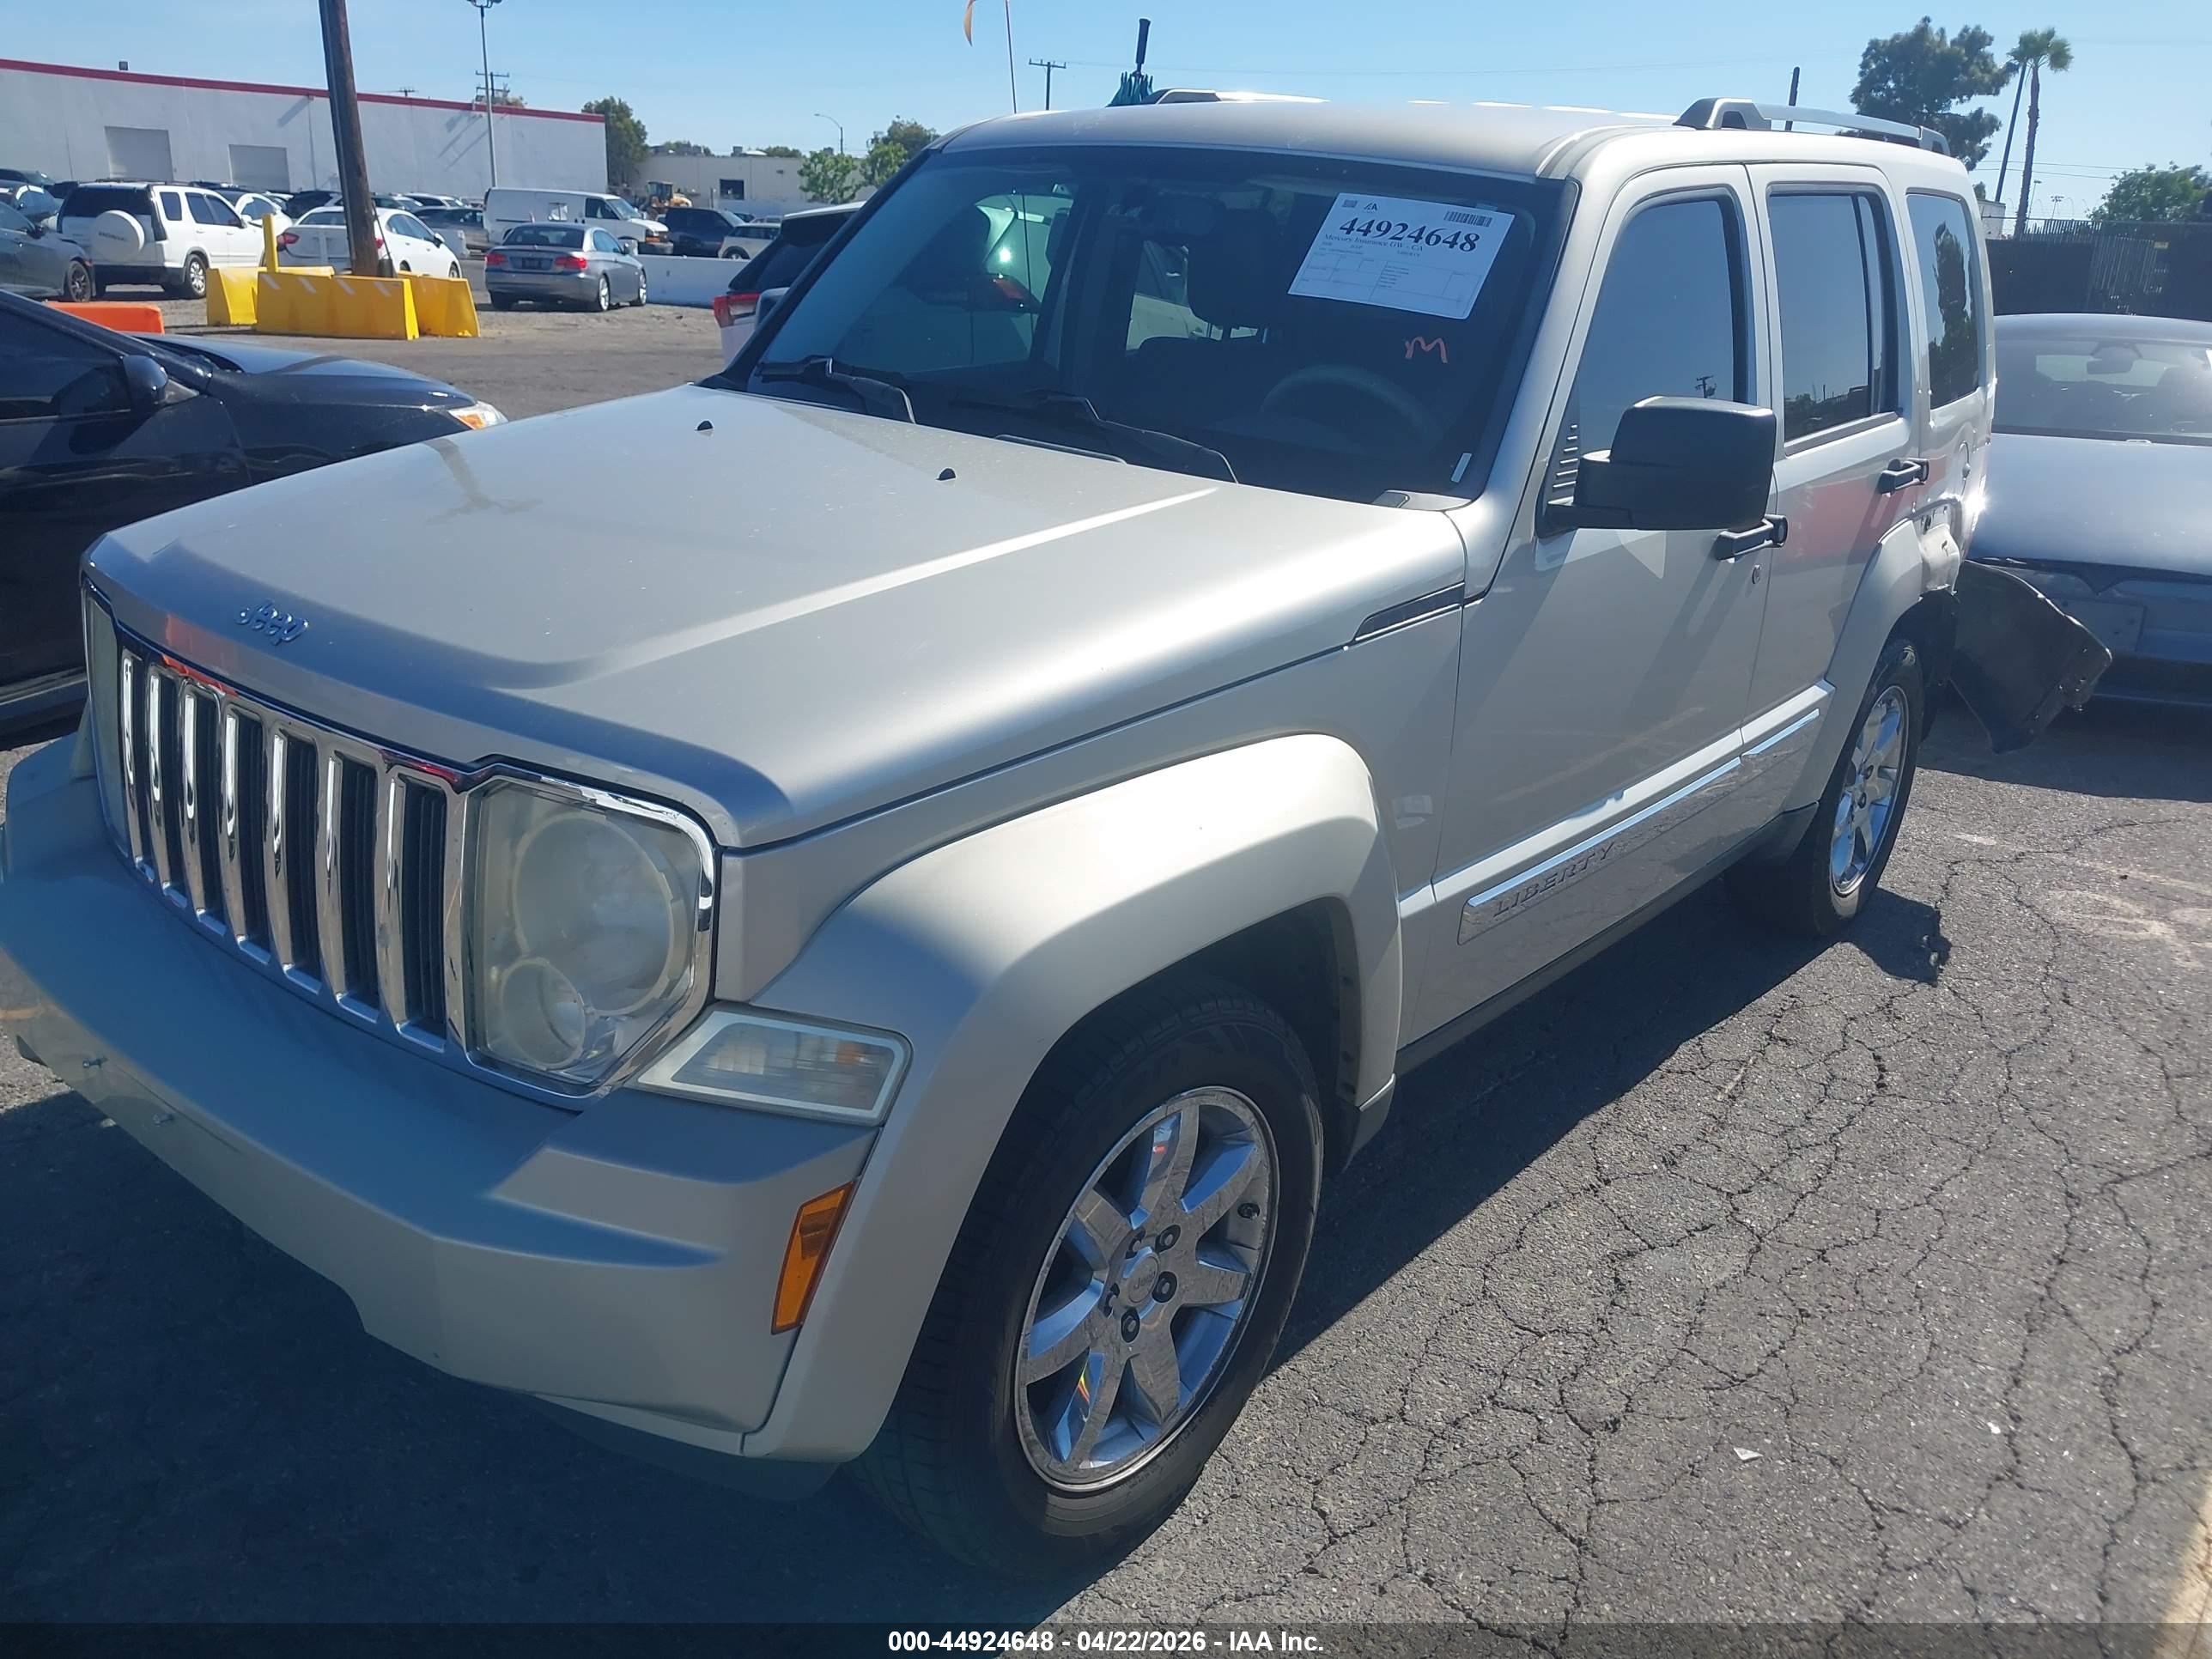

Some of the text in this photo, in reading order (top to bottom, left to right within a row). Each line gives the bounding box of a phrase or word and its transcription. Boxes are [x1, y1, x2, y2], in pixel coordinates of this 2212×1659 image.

[1340, 216, 1480, 252] 44924648
[234, 599, 310, 646] Jeep
[1492, 842, 1615, 918] LIBERTY
